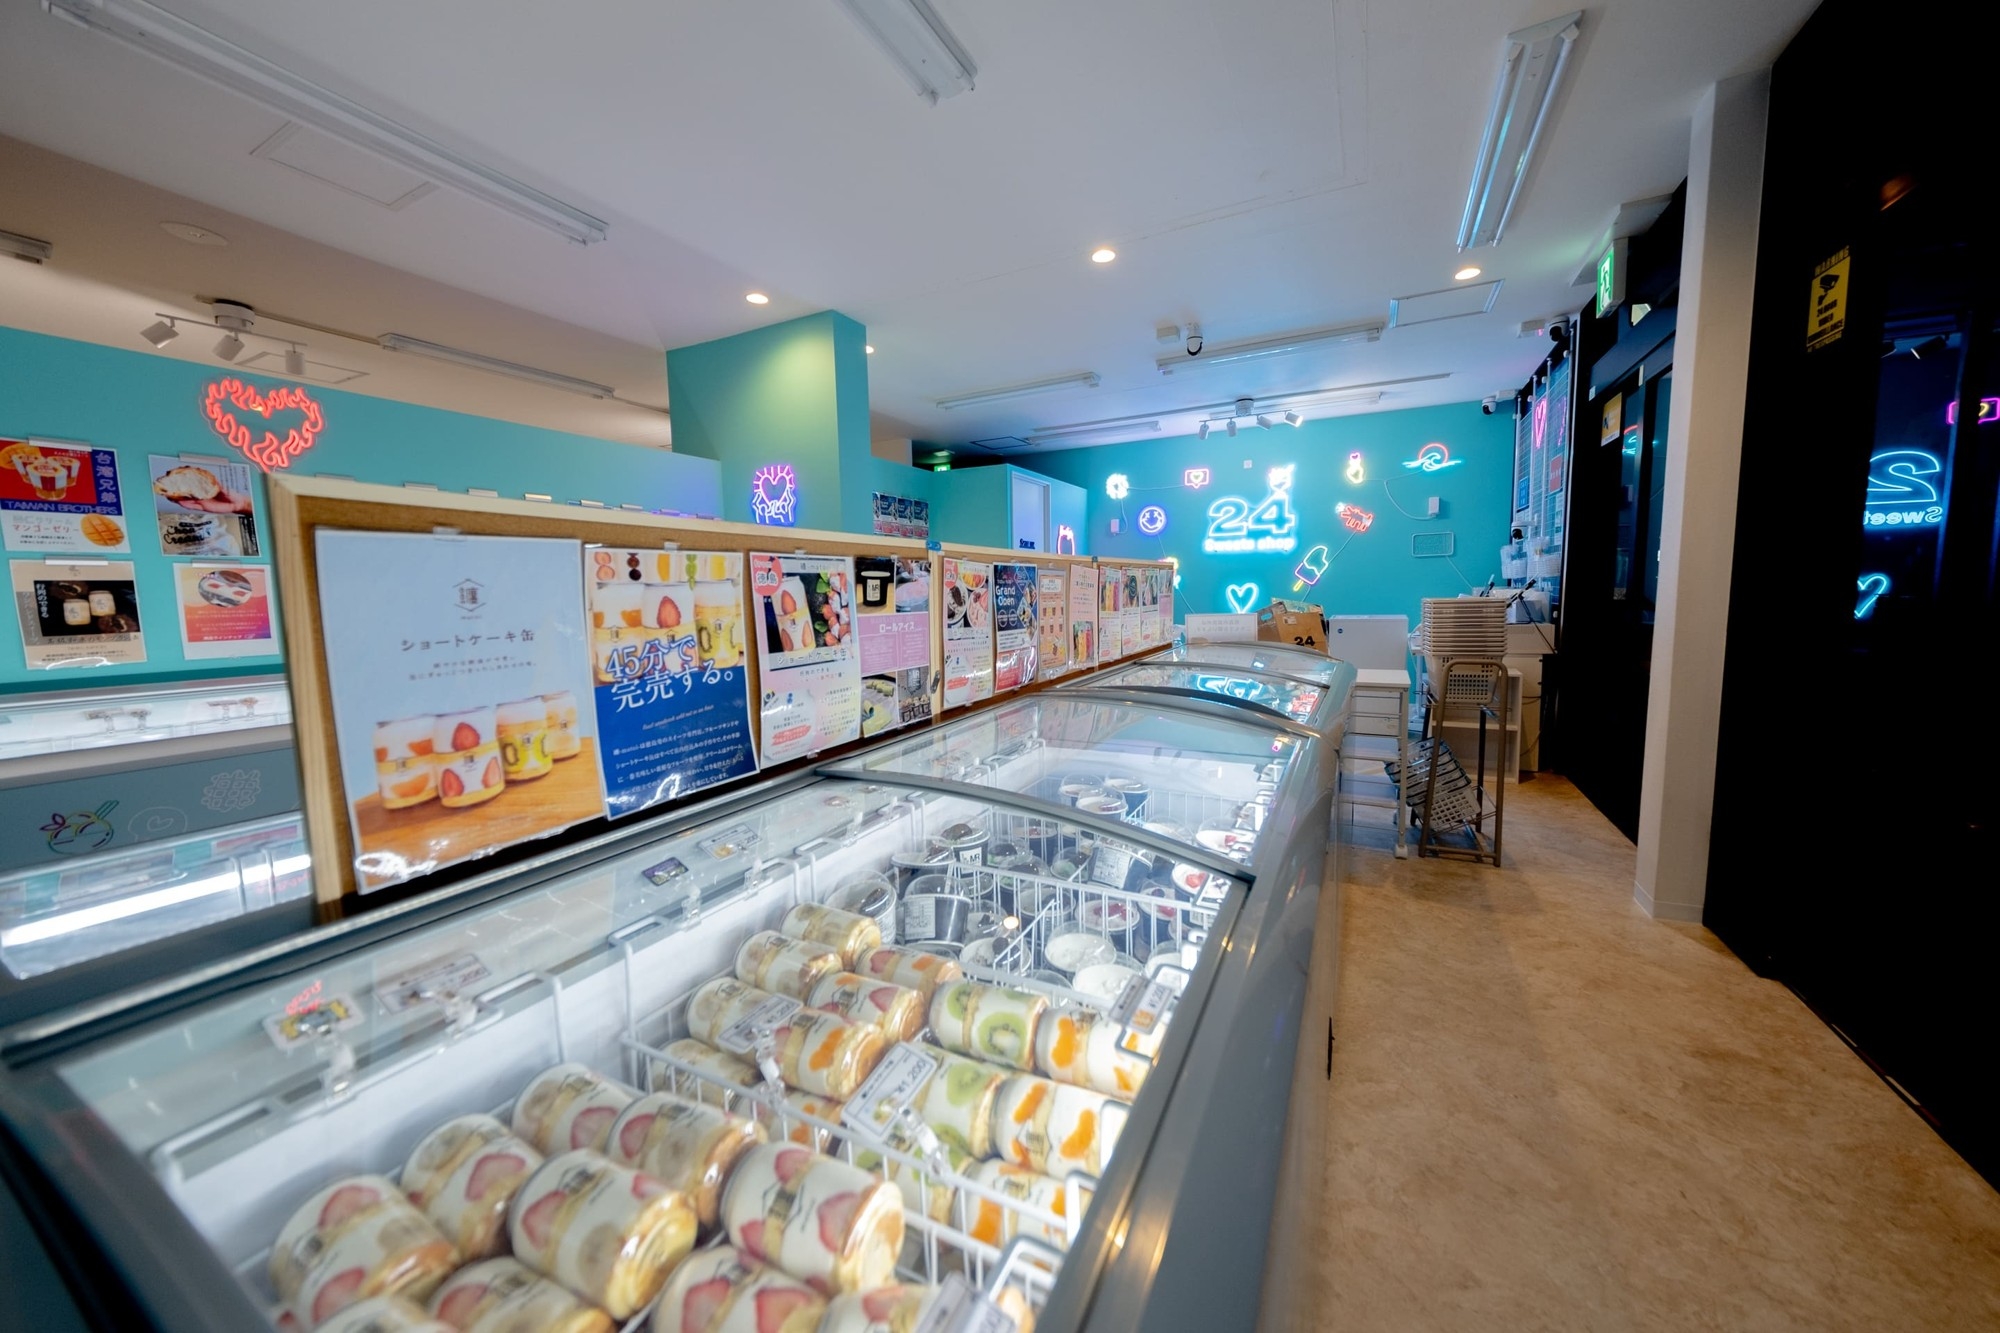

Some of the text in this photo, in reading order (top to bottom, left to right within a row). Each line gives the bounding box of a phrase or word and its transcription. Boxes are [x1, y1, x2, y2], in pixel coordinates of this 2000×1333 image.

[1813, 244, 1850, 278] WARNING
[5, 500, 118, 515] TAIWAN BROTHERS
[1208, 496, 1296, 537] 24
[12, 524, 79, 533] マンゴーゼリー
[756, 571, 778, 586] 徳島
[995, 585, 1016, 595] Grand
[997, 596, 1015, 606] Open
[879, 621, 915, 633] ロールアイス
[401, 628, 535, 651] ショートケーキ缶
[1293, 635, 1316, 647] 24
[606, 635, 697, 679] 45分で
[611, 659, 734, 713] 完売する。
[896, 1059, 927, 1094] ¥1,200
